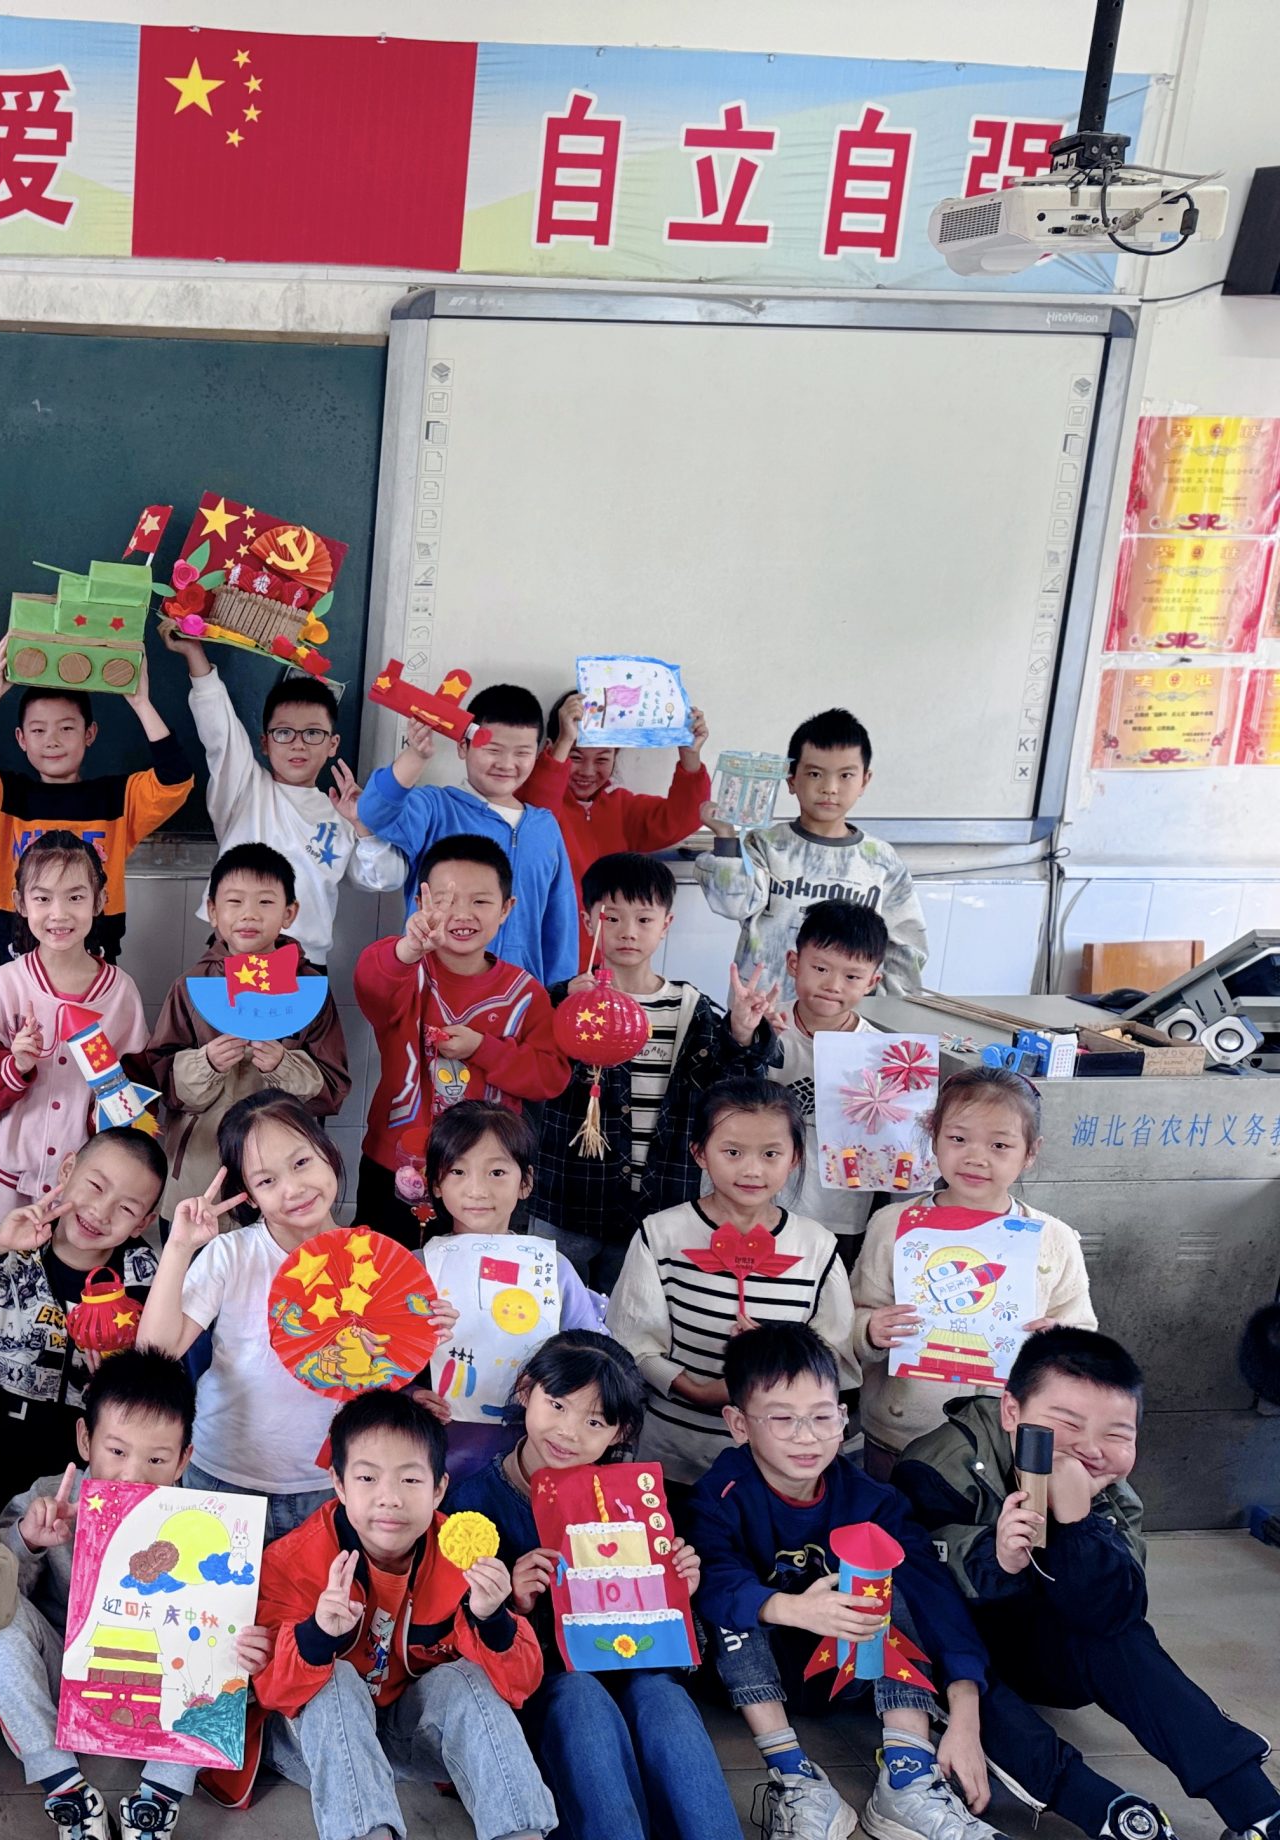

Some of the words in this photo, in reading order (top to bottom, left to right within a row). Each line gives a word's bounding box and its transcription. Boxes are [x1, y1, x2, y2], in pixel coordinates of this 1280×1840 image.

[1046, 312, 1098, 328] HiteVision
[102, 1595, 152, 1621] 迎国庆
[162, 1605, 220, 1628] 庆中秋
